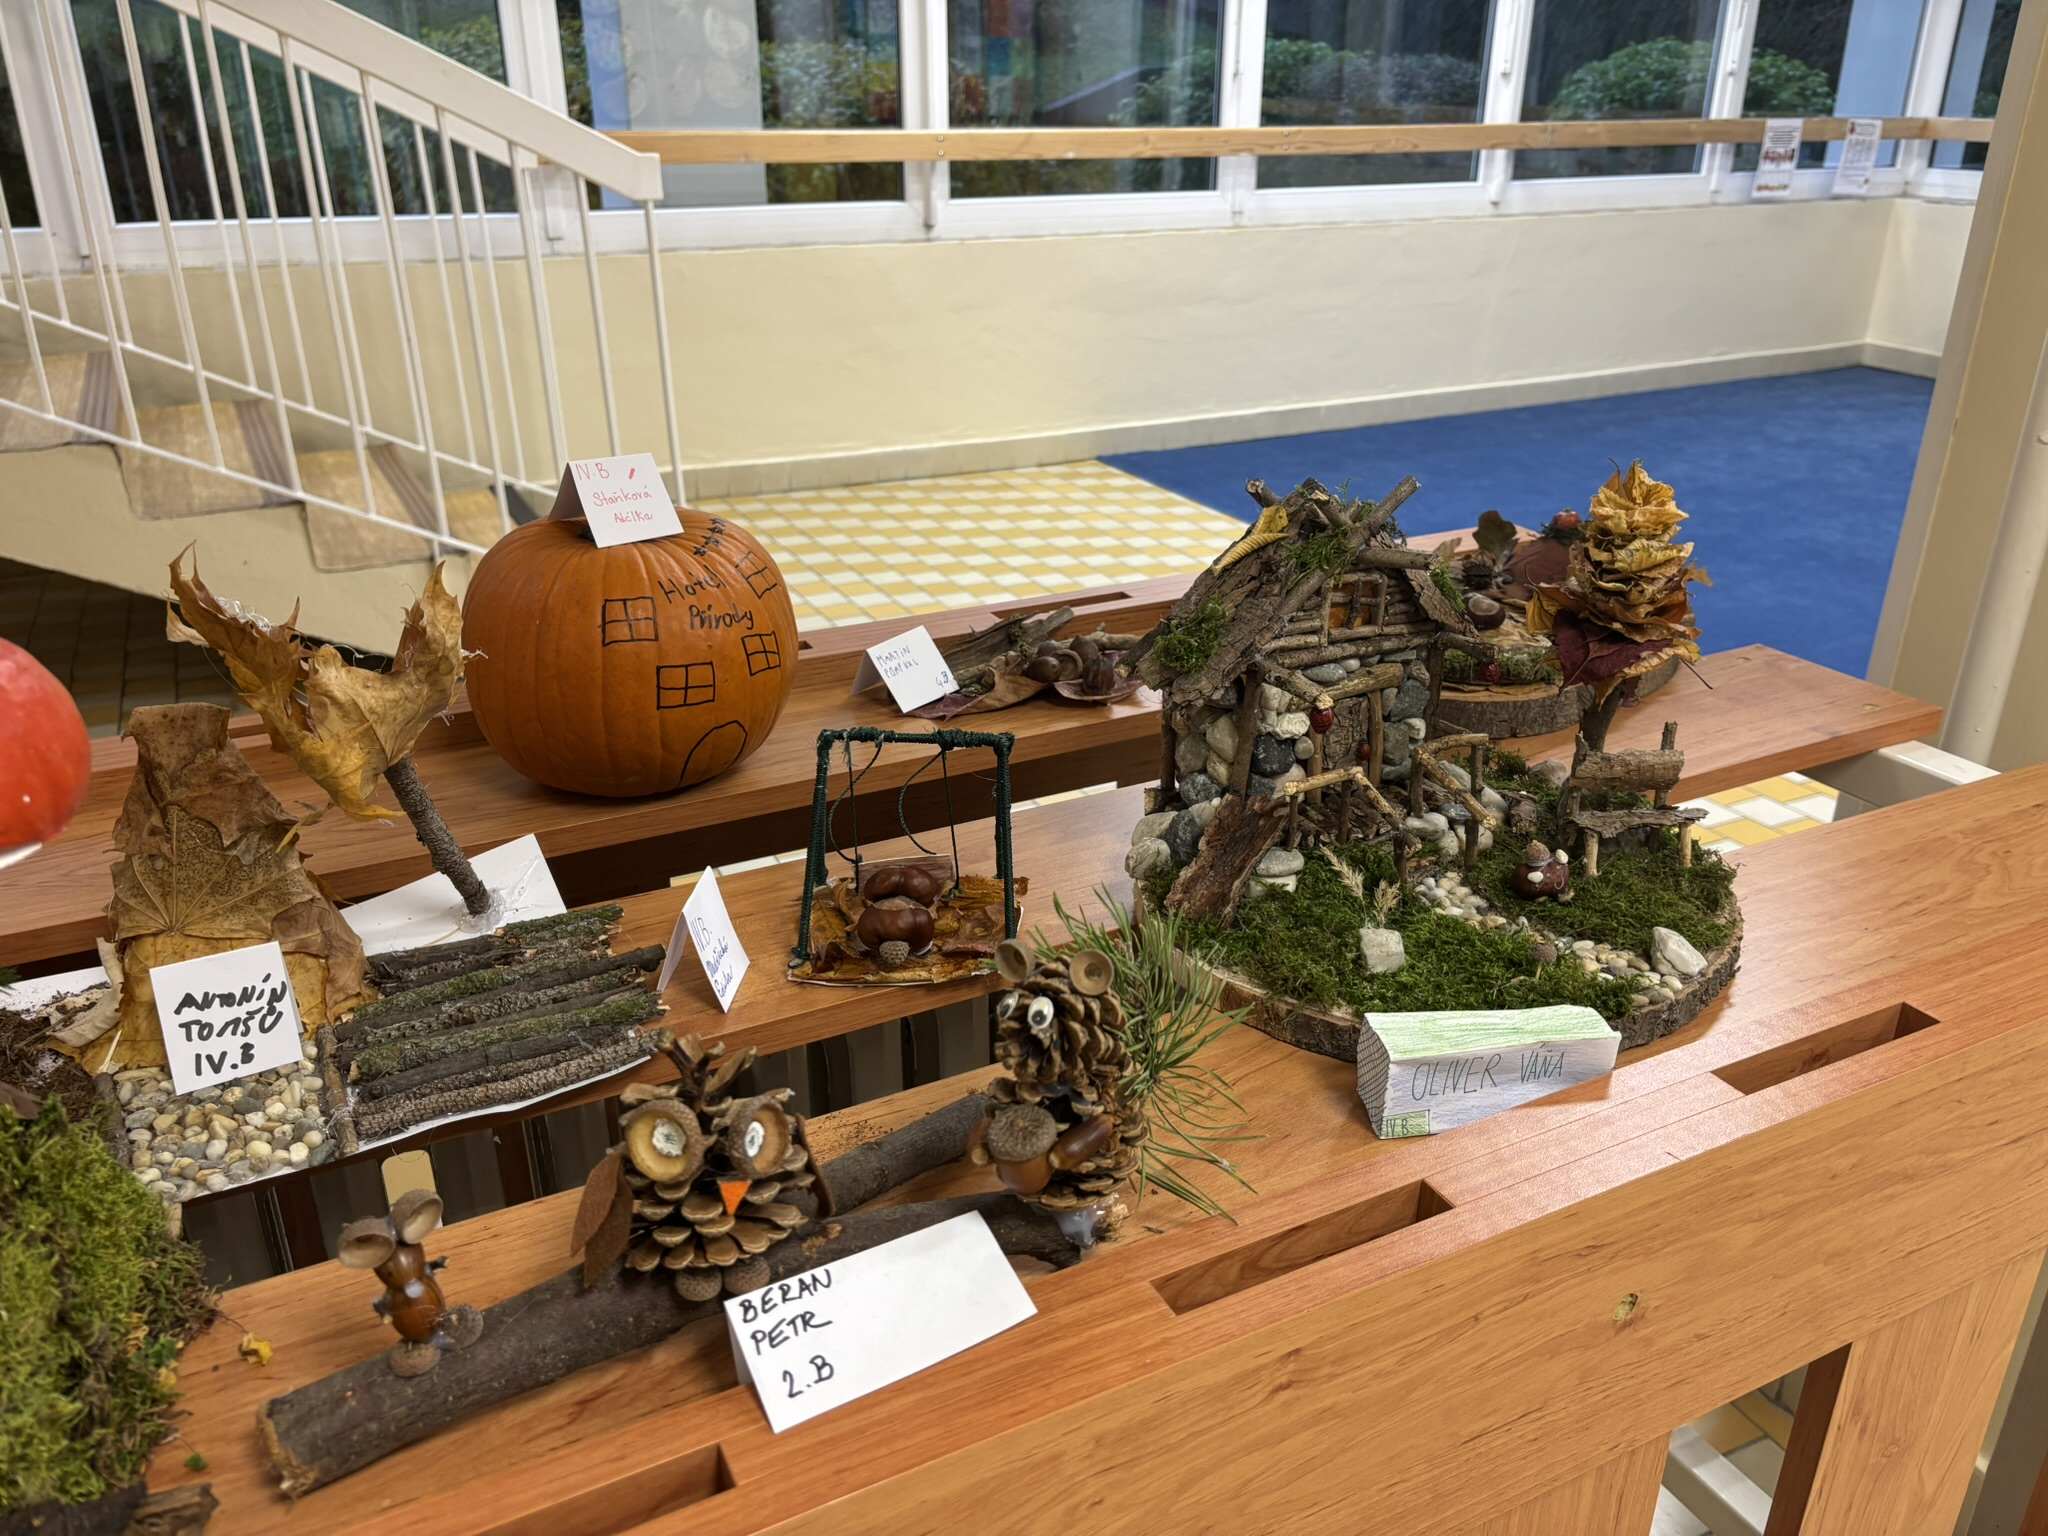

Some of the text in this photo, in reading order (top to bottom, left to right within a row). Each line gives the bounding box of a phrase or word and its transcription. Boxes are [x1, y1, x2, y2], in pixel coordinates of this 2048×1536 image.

[194, 1042, 255, 1076] IV.B
[1411, 1043, 1565, 1101] OLIVER VÁŇA
[739, 1268, 832, 1323] BERAN
[750, 1311, 833, 1355] PETR
[782, 1354, 834, 1398] 2.B
